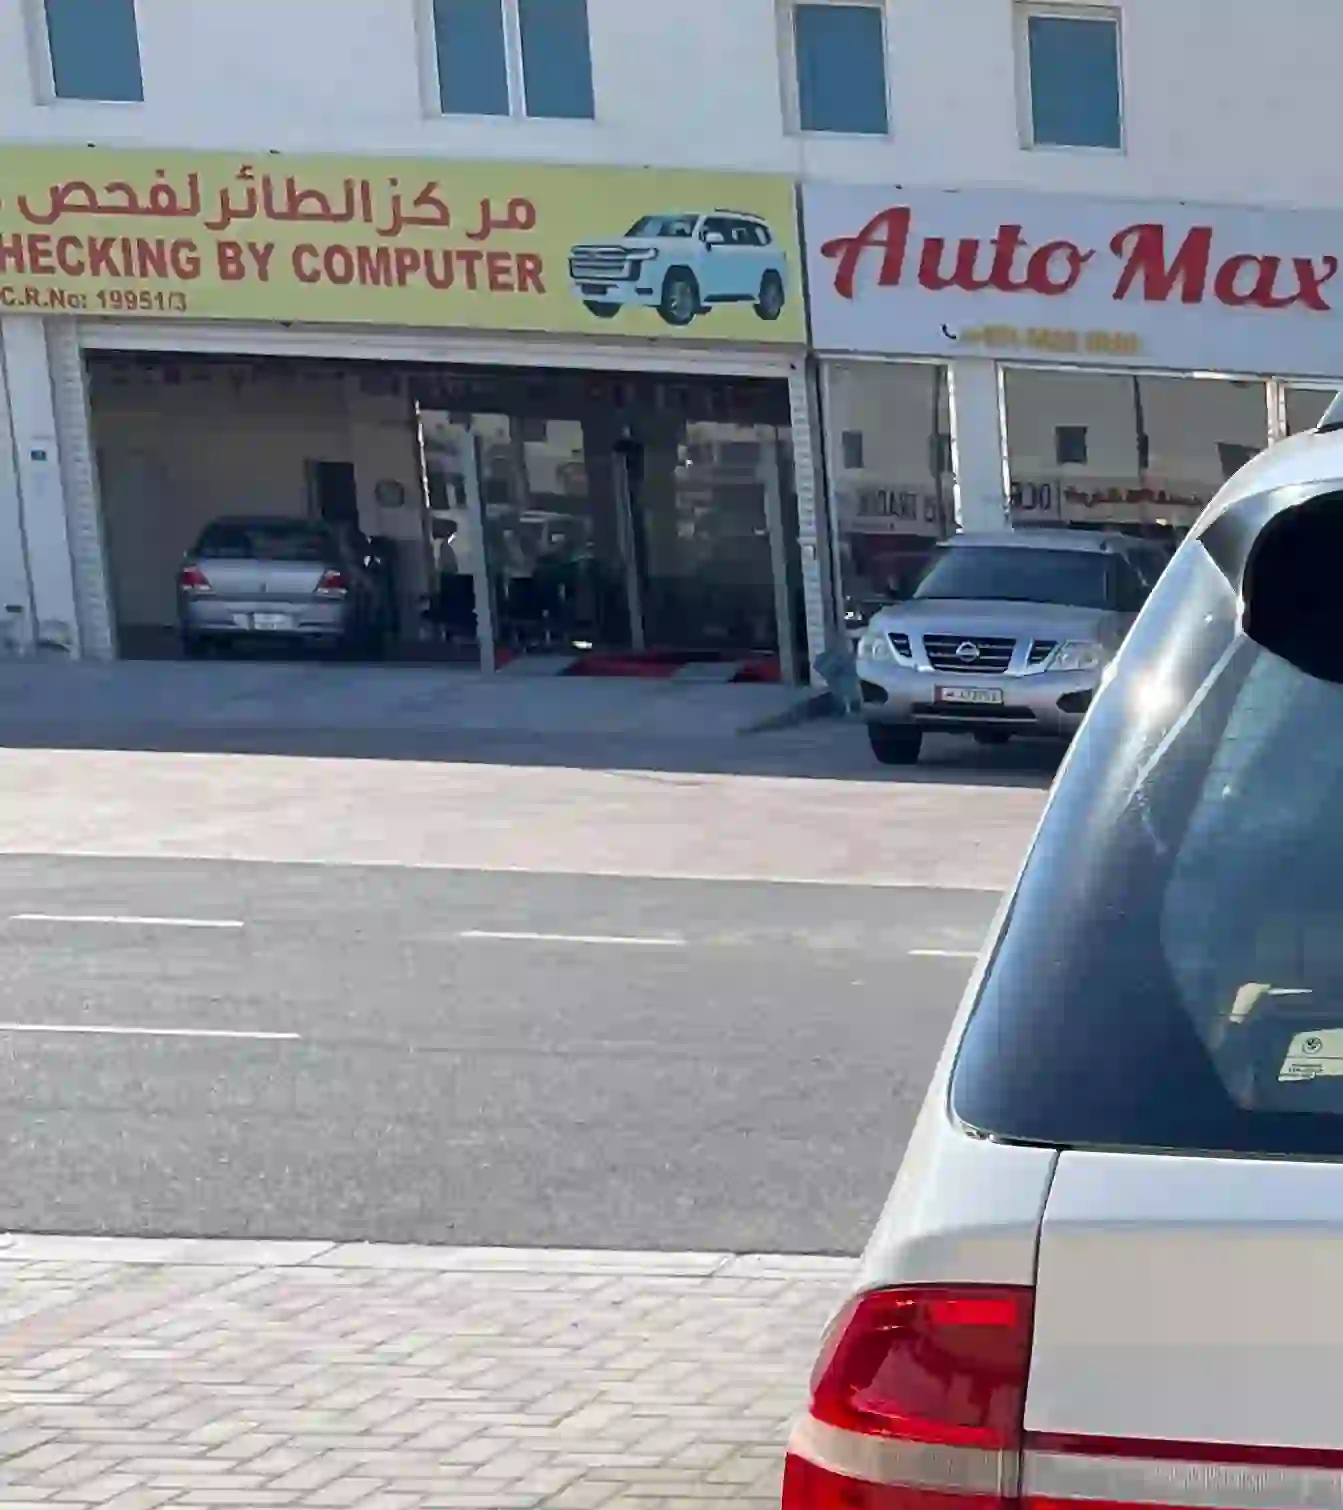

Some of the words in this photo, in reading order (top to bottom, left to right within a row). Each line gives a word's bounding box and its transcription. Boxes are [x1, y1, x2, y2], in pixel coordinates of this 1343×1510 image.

[17, 167, 202, 226] لفحص
[375, 176, 537, 241] مركز
[215, 240, 275, 282] BY
[291, 242, 547, 295] COMPUTER
[820, 206, 1097, 300] Auto
[1108, 222, 1339, 312] Max
